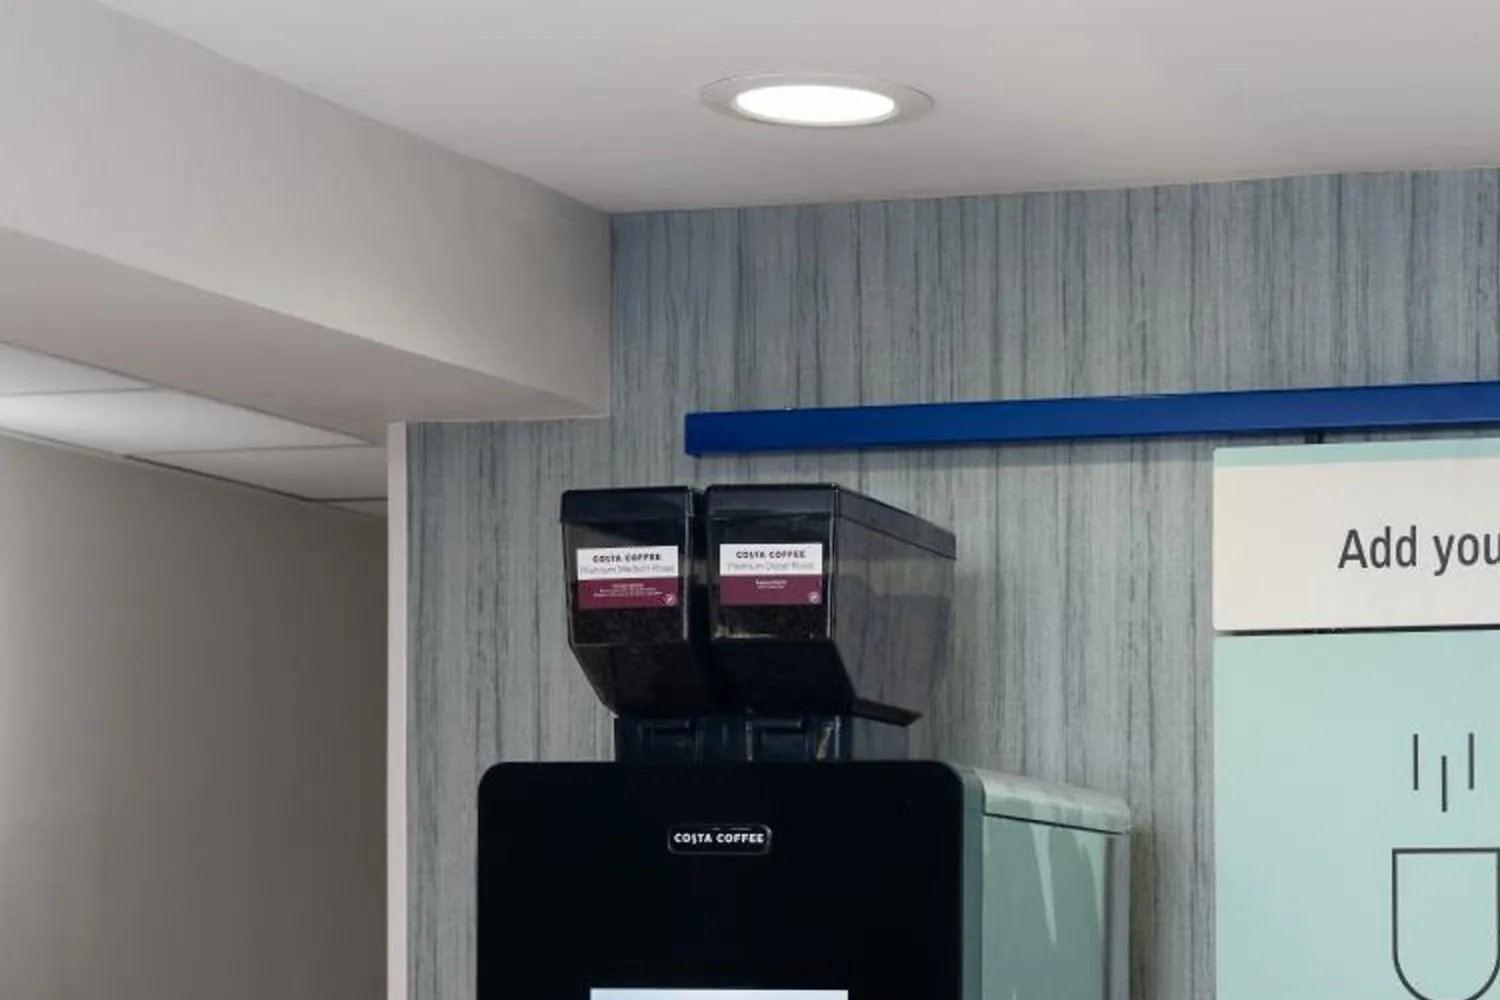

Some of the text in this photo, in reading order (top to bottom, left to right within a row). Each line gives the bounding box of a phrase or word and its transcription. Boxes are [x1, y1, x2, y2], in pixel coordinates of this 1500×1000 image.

[1337, 525, 1417, 569] Add
[592, 552, 662, 564] COSTA COFFEE
[736, 549, 807, 559] COSTA COFFEE
[673, 832, 765, 845] COSTA COFFEE
